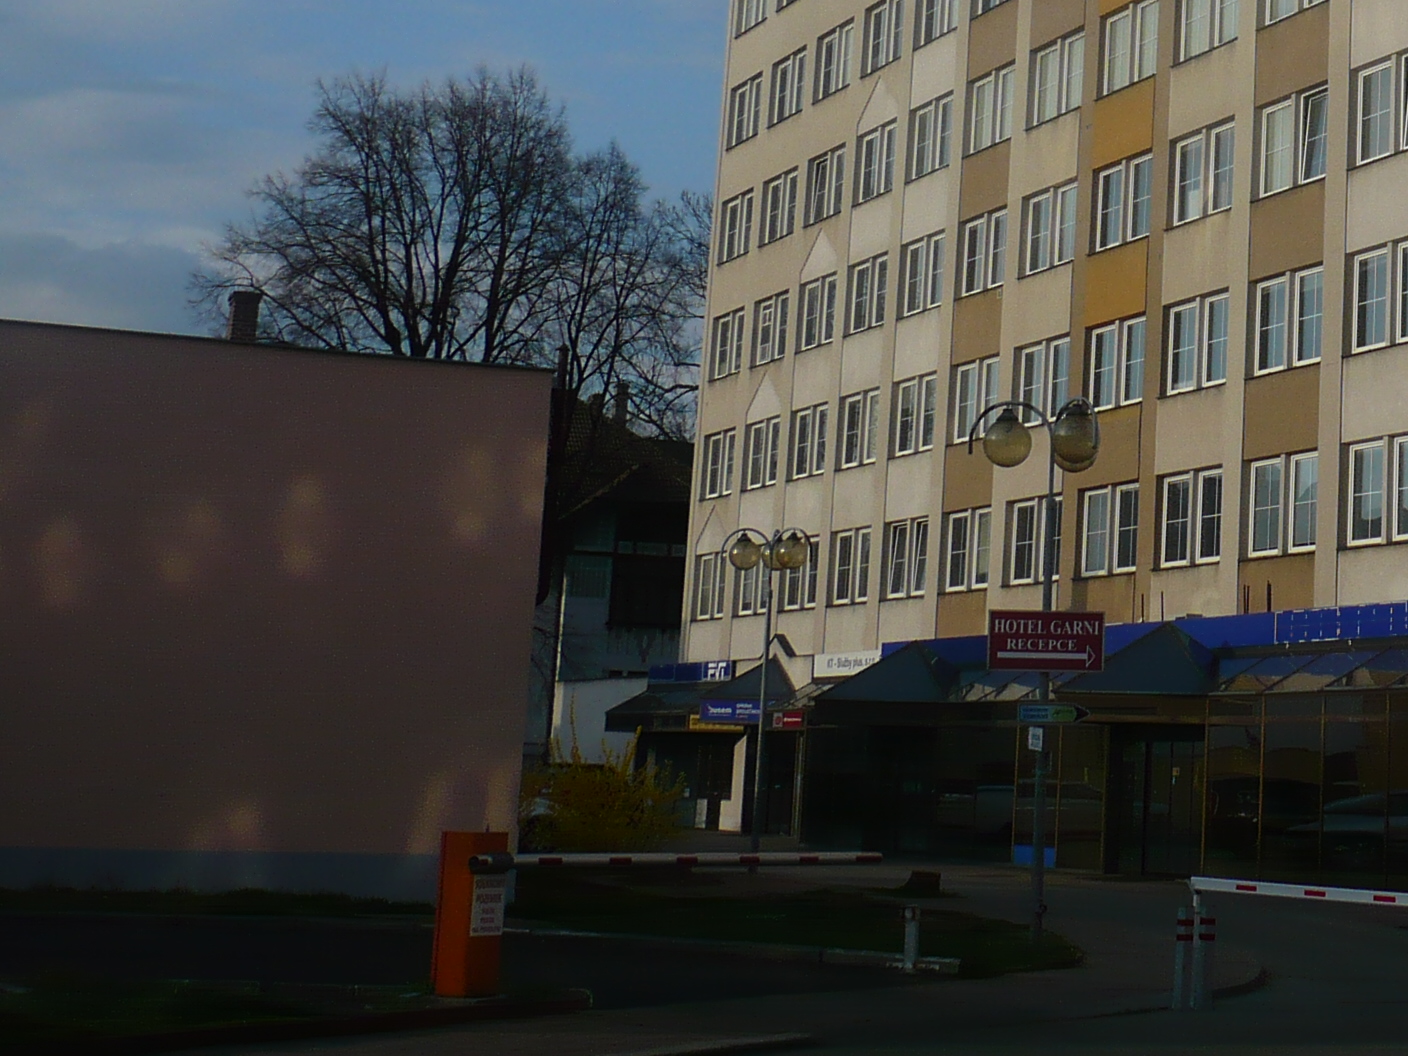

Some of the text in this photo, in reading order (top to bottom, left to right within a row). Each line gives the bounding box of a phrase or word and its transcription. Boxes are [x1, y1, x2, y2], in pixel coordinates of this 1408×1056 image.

[994, 619, 1100, 636] HOTEL GARNI
[1006, 638, 1077, 651] RECEPCE
